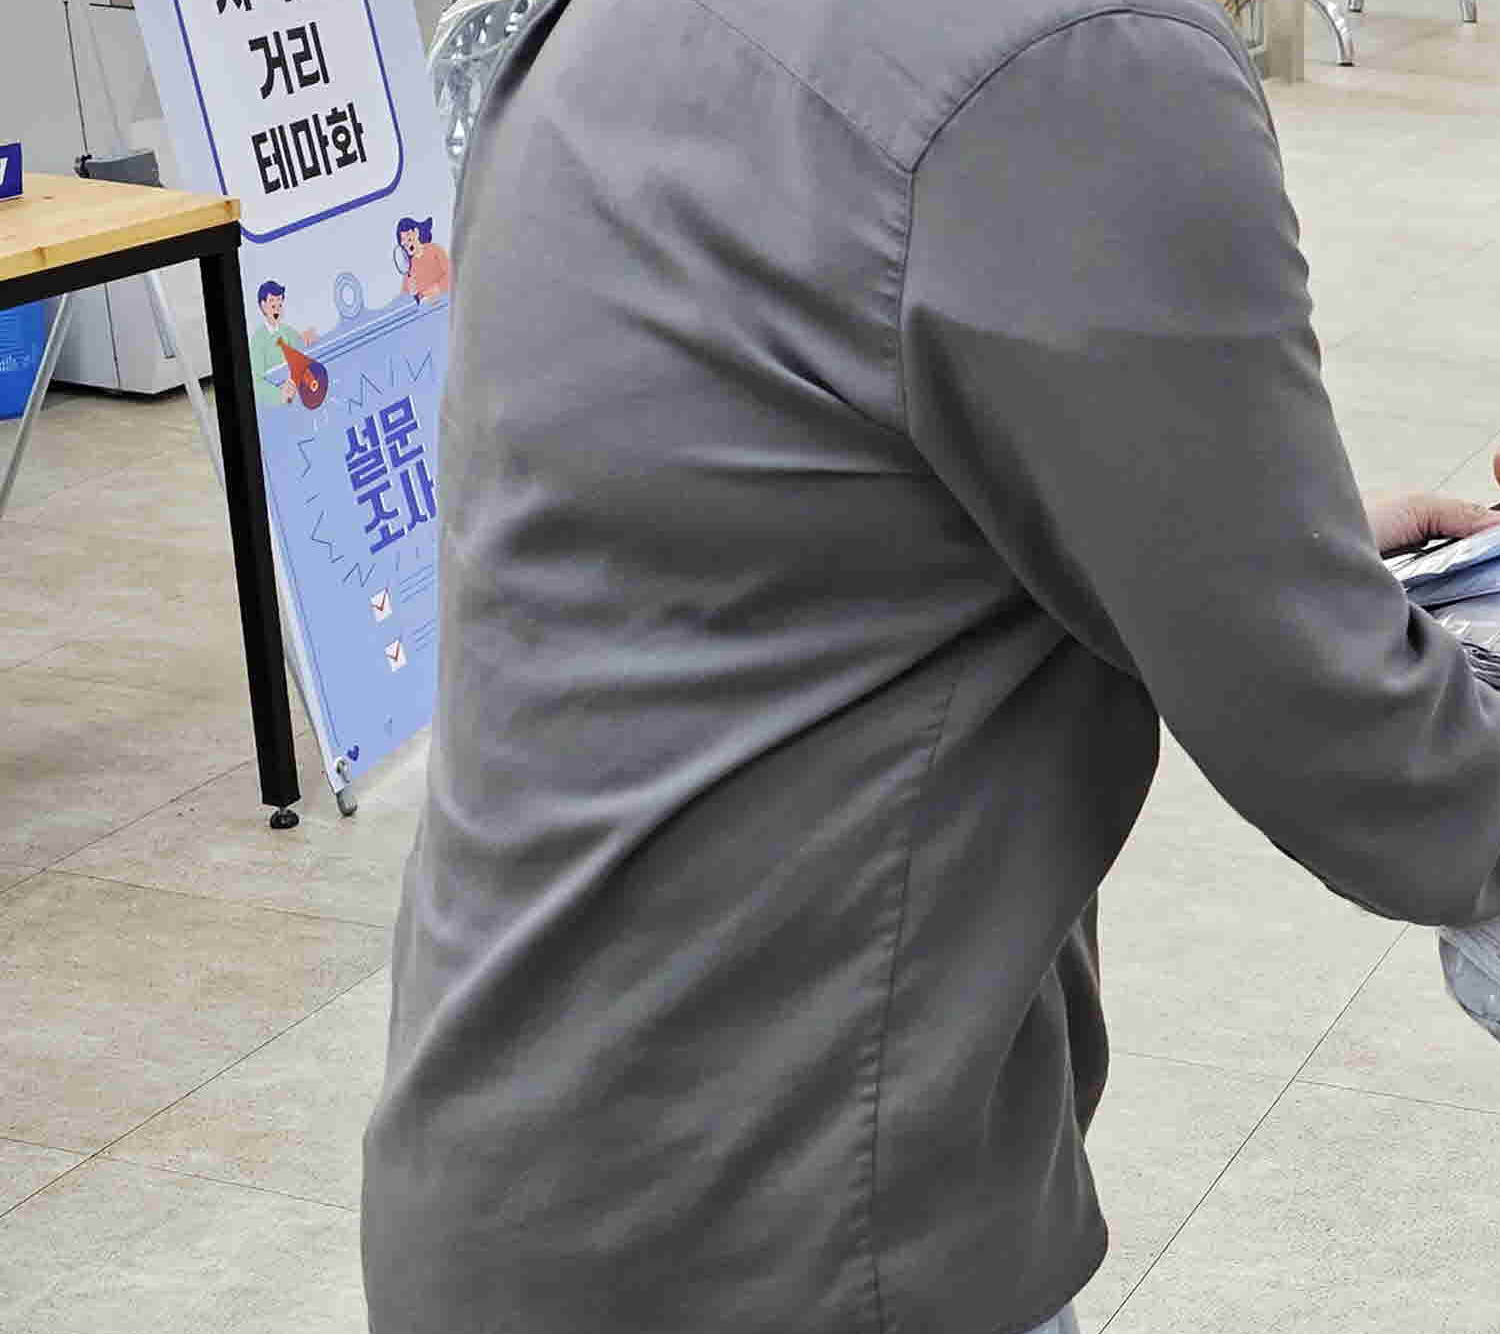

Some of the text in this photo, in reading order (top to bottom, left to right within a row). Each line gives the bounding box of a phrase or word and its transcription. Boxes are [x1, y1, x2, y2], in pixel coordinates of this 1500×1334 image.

[248, 21, 330, 100] 거리
[250, 102, 367, 195] 테마화
[345, 395, 425, 492] 설문
[356, 458, 437, 555] 조사
